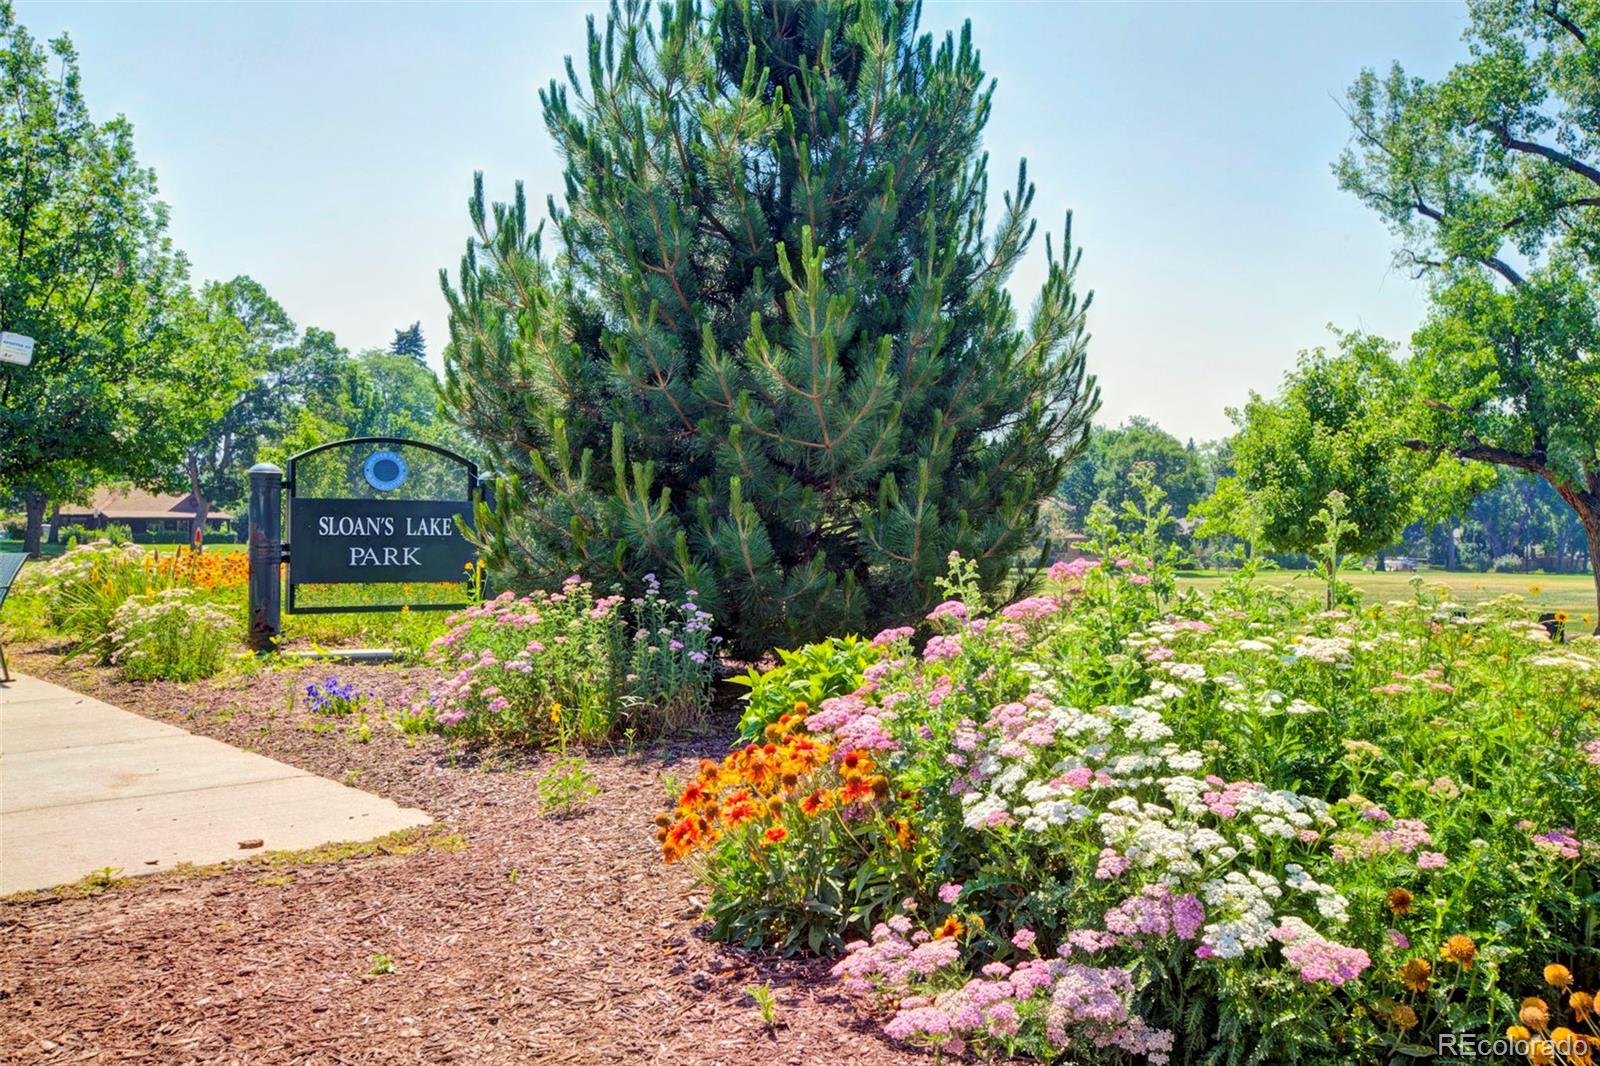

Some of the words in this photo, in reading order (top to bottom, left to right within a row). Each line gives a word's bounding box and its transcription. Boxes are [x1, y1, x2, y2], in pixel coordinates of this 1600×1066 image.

[318, 516, 394, 536] SLOAN'S
[406, 517, 452, 536] LAKE
[349, 547, 422, 566] PARK
